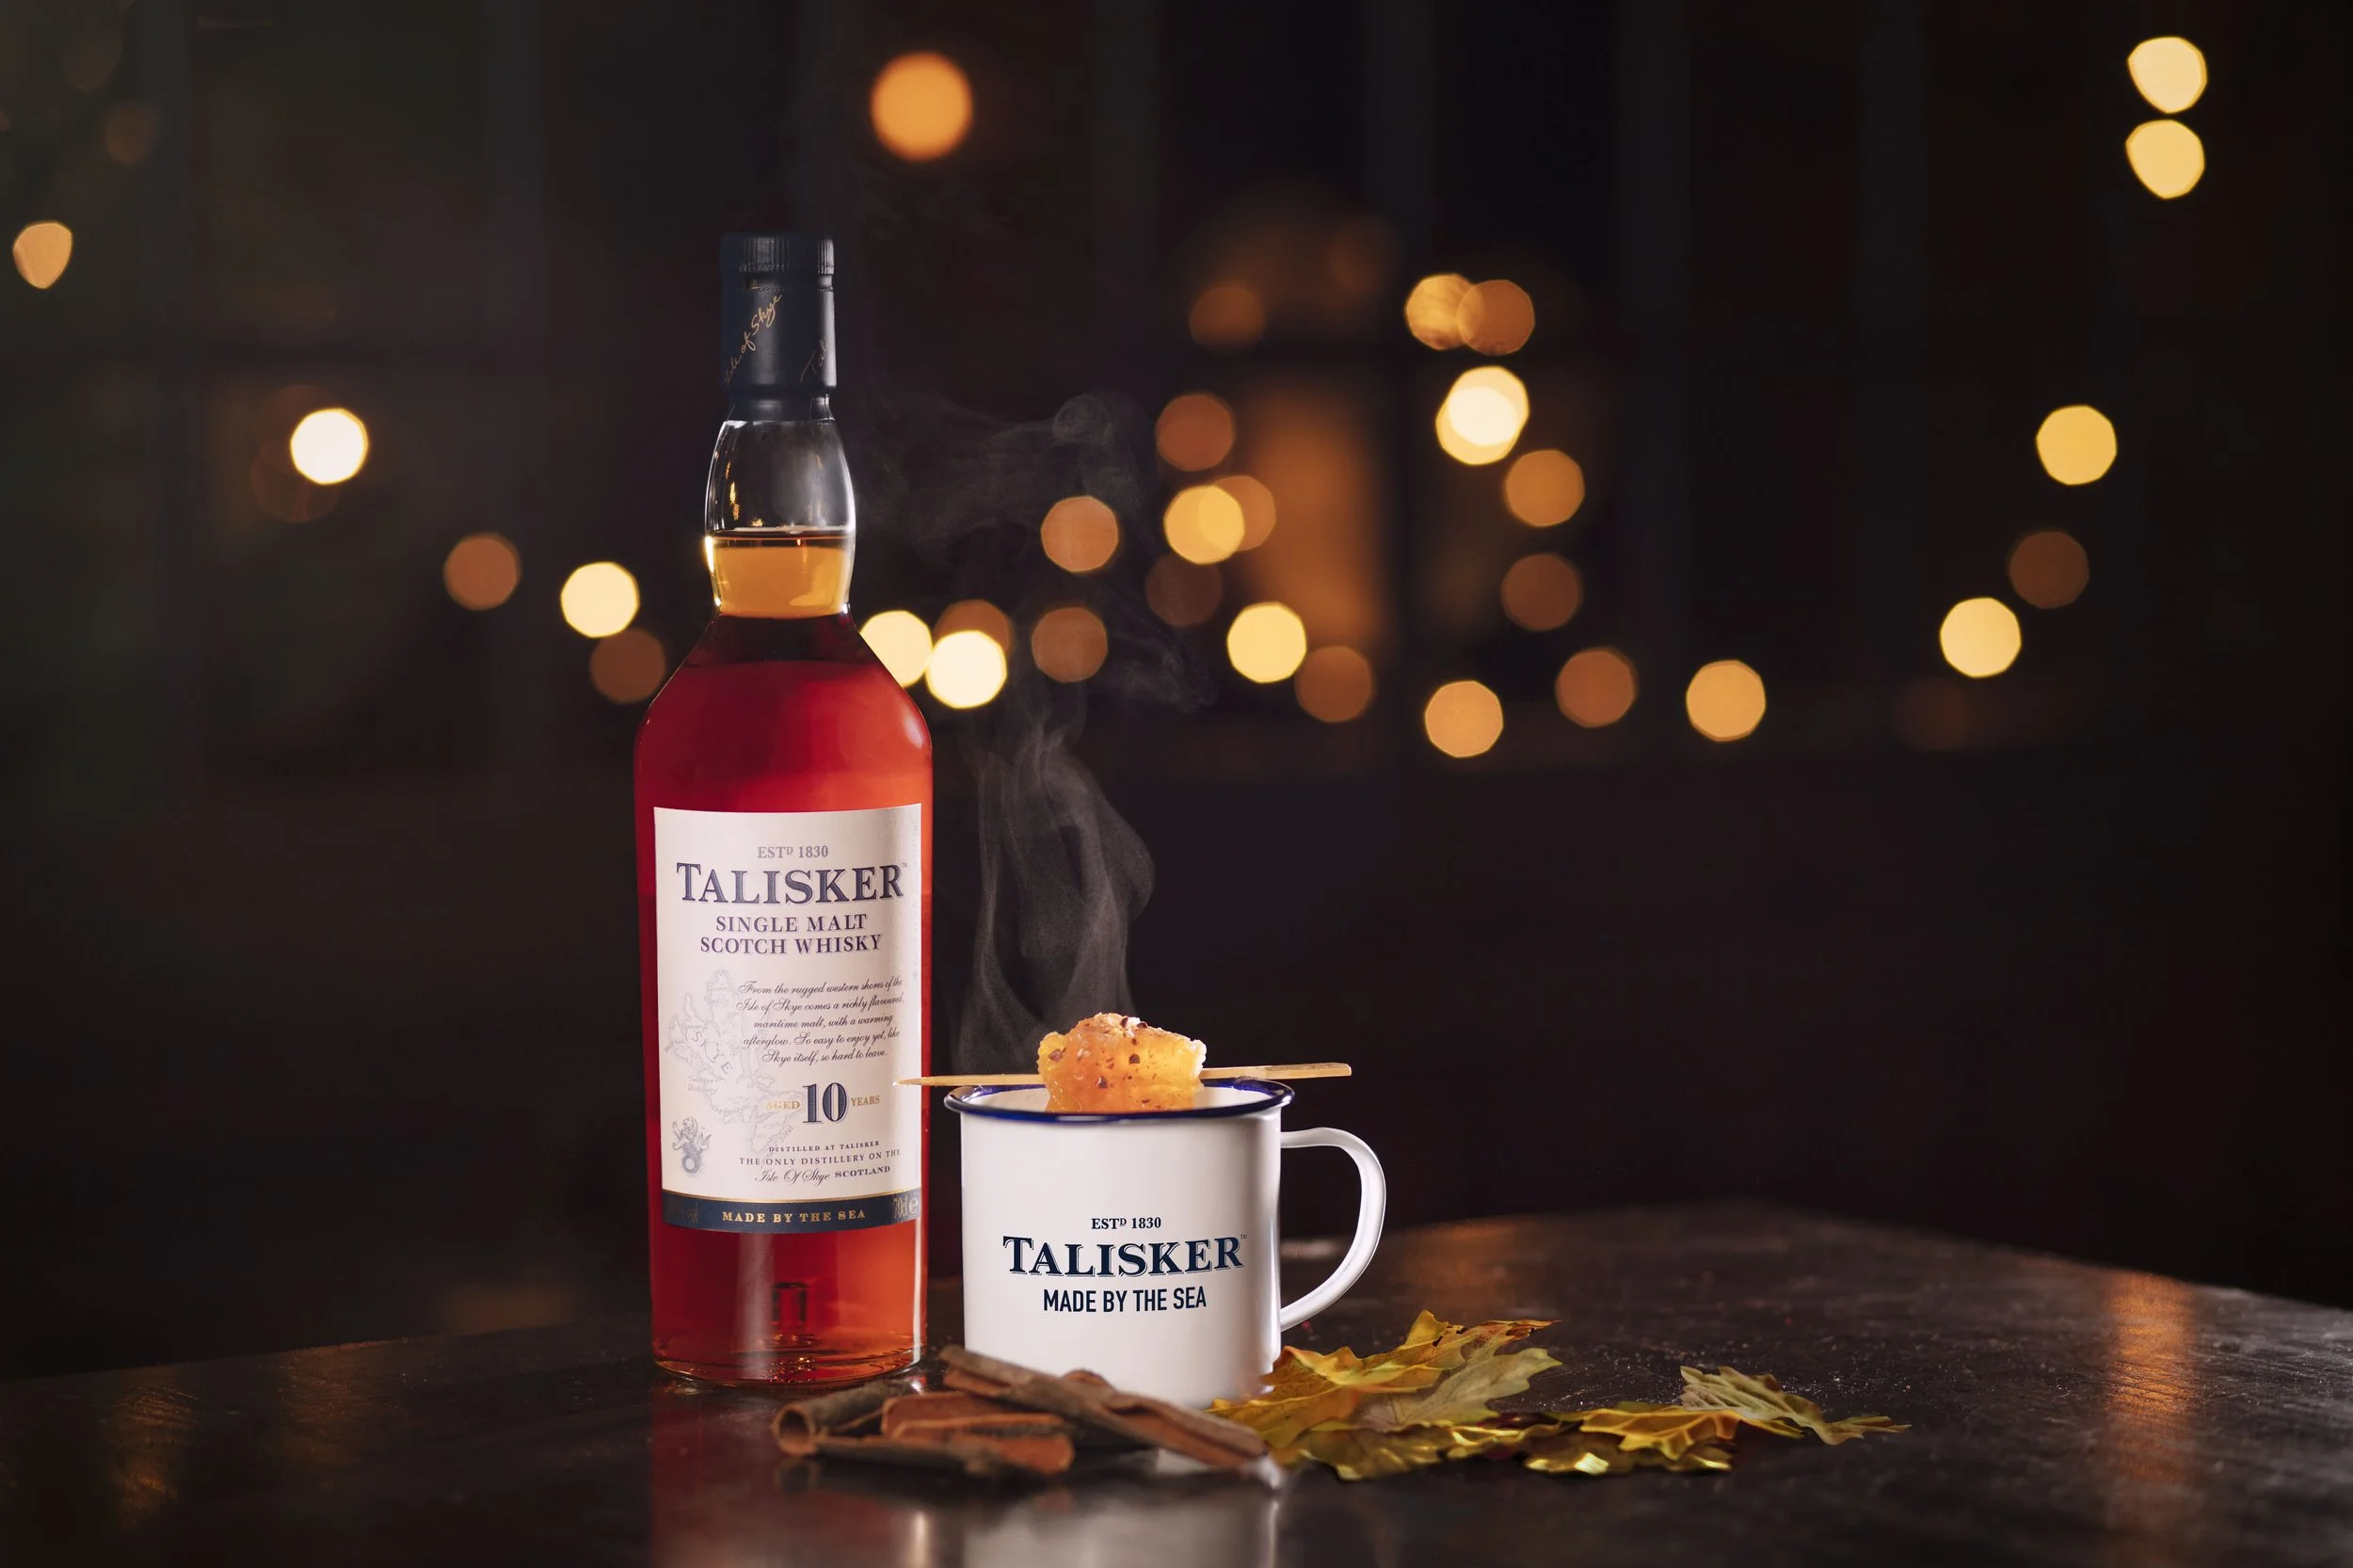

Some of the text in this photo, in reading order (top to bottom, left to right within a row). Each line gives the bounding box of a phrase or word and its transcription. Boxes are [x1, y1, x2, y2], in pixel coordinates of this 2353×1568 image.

[741, 331, 756, 352] of
[751, 295, 782, 336] Skye
[798, 845, 828, 858] 1830
[676, 862, 904, 904] TALISKER
[715, 914, 867, 933] SINGLE MALT
[700, 934, 883, 954] SCOTCH WHISKY
[739, 981, 771, 994] From
[775, 983, 789, 994] the
[792, 982, 827, 999] rugged
[827, 982, 858, 992] western
[861, 979, 884, 990] shores
[885, 976, 893, 992] of
[736, 998, 759, 1011] Isle
[760, 1000, 773, 1015] of
[773, 998, 802, 1016] Skye
[841, 996, 868, 1012] richly
[754, 1018, 798, 1028] maritime
[801, 1016, 825, 1029] malt,
[828, 1016, 848, 1027] with
[857, 1014, 893, 1026] warming
[744, 1034, 792, 1049] afterglow.
[794, 1032, 811, 1045] So
[813, 1038, 834, 1048] easy
[836, 1034, 844, 1043] to
[846, 1034, 871, 1047] enjoy
[762, 1048, 792, 1067] Skye
[793, 1050, 819, 1066] itself,
[831, 1049, 854, 1061] hard
[856, 1049, 864, 1059] to
[865, 1047, 888, 1058] leave.
[765, 1100, 800, 1111] AGED
[802, 1082, 849, 1125] 10
[851, 1095, 880, 1107] YEARS
[840, 1141, 880, 1149] TALISKER
[765, 1158, 796, 1166] ONLY
[801, 1155, 865, 1165] DISTILLERY
[886, 1149, 901, 1158] THE
[755, 1168, 778, 1183] Isle
[802, 1168, 830, 1186] Skye
[835, 1166, 890, 1178] SCOTLAND
[723, 1209, 866, 1223] MADE BY THE SEA
[1131, 1217, 1161, 1229] 1830
[1002, 1235, 1244, 1277] TALISKER
[1044, 1286, 1207, 1313] MADE BY THE SEA
